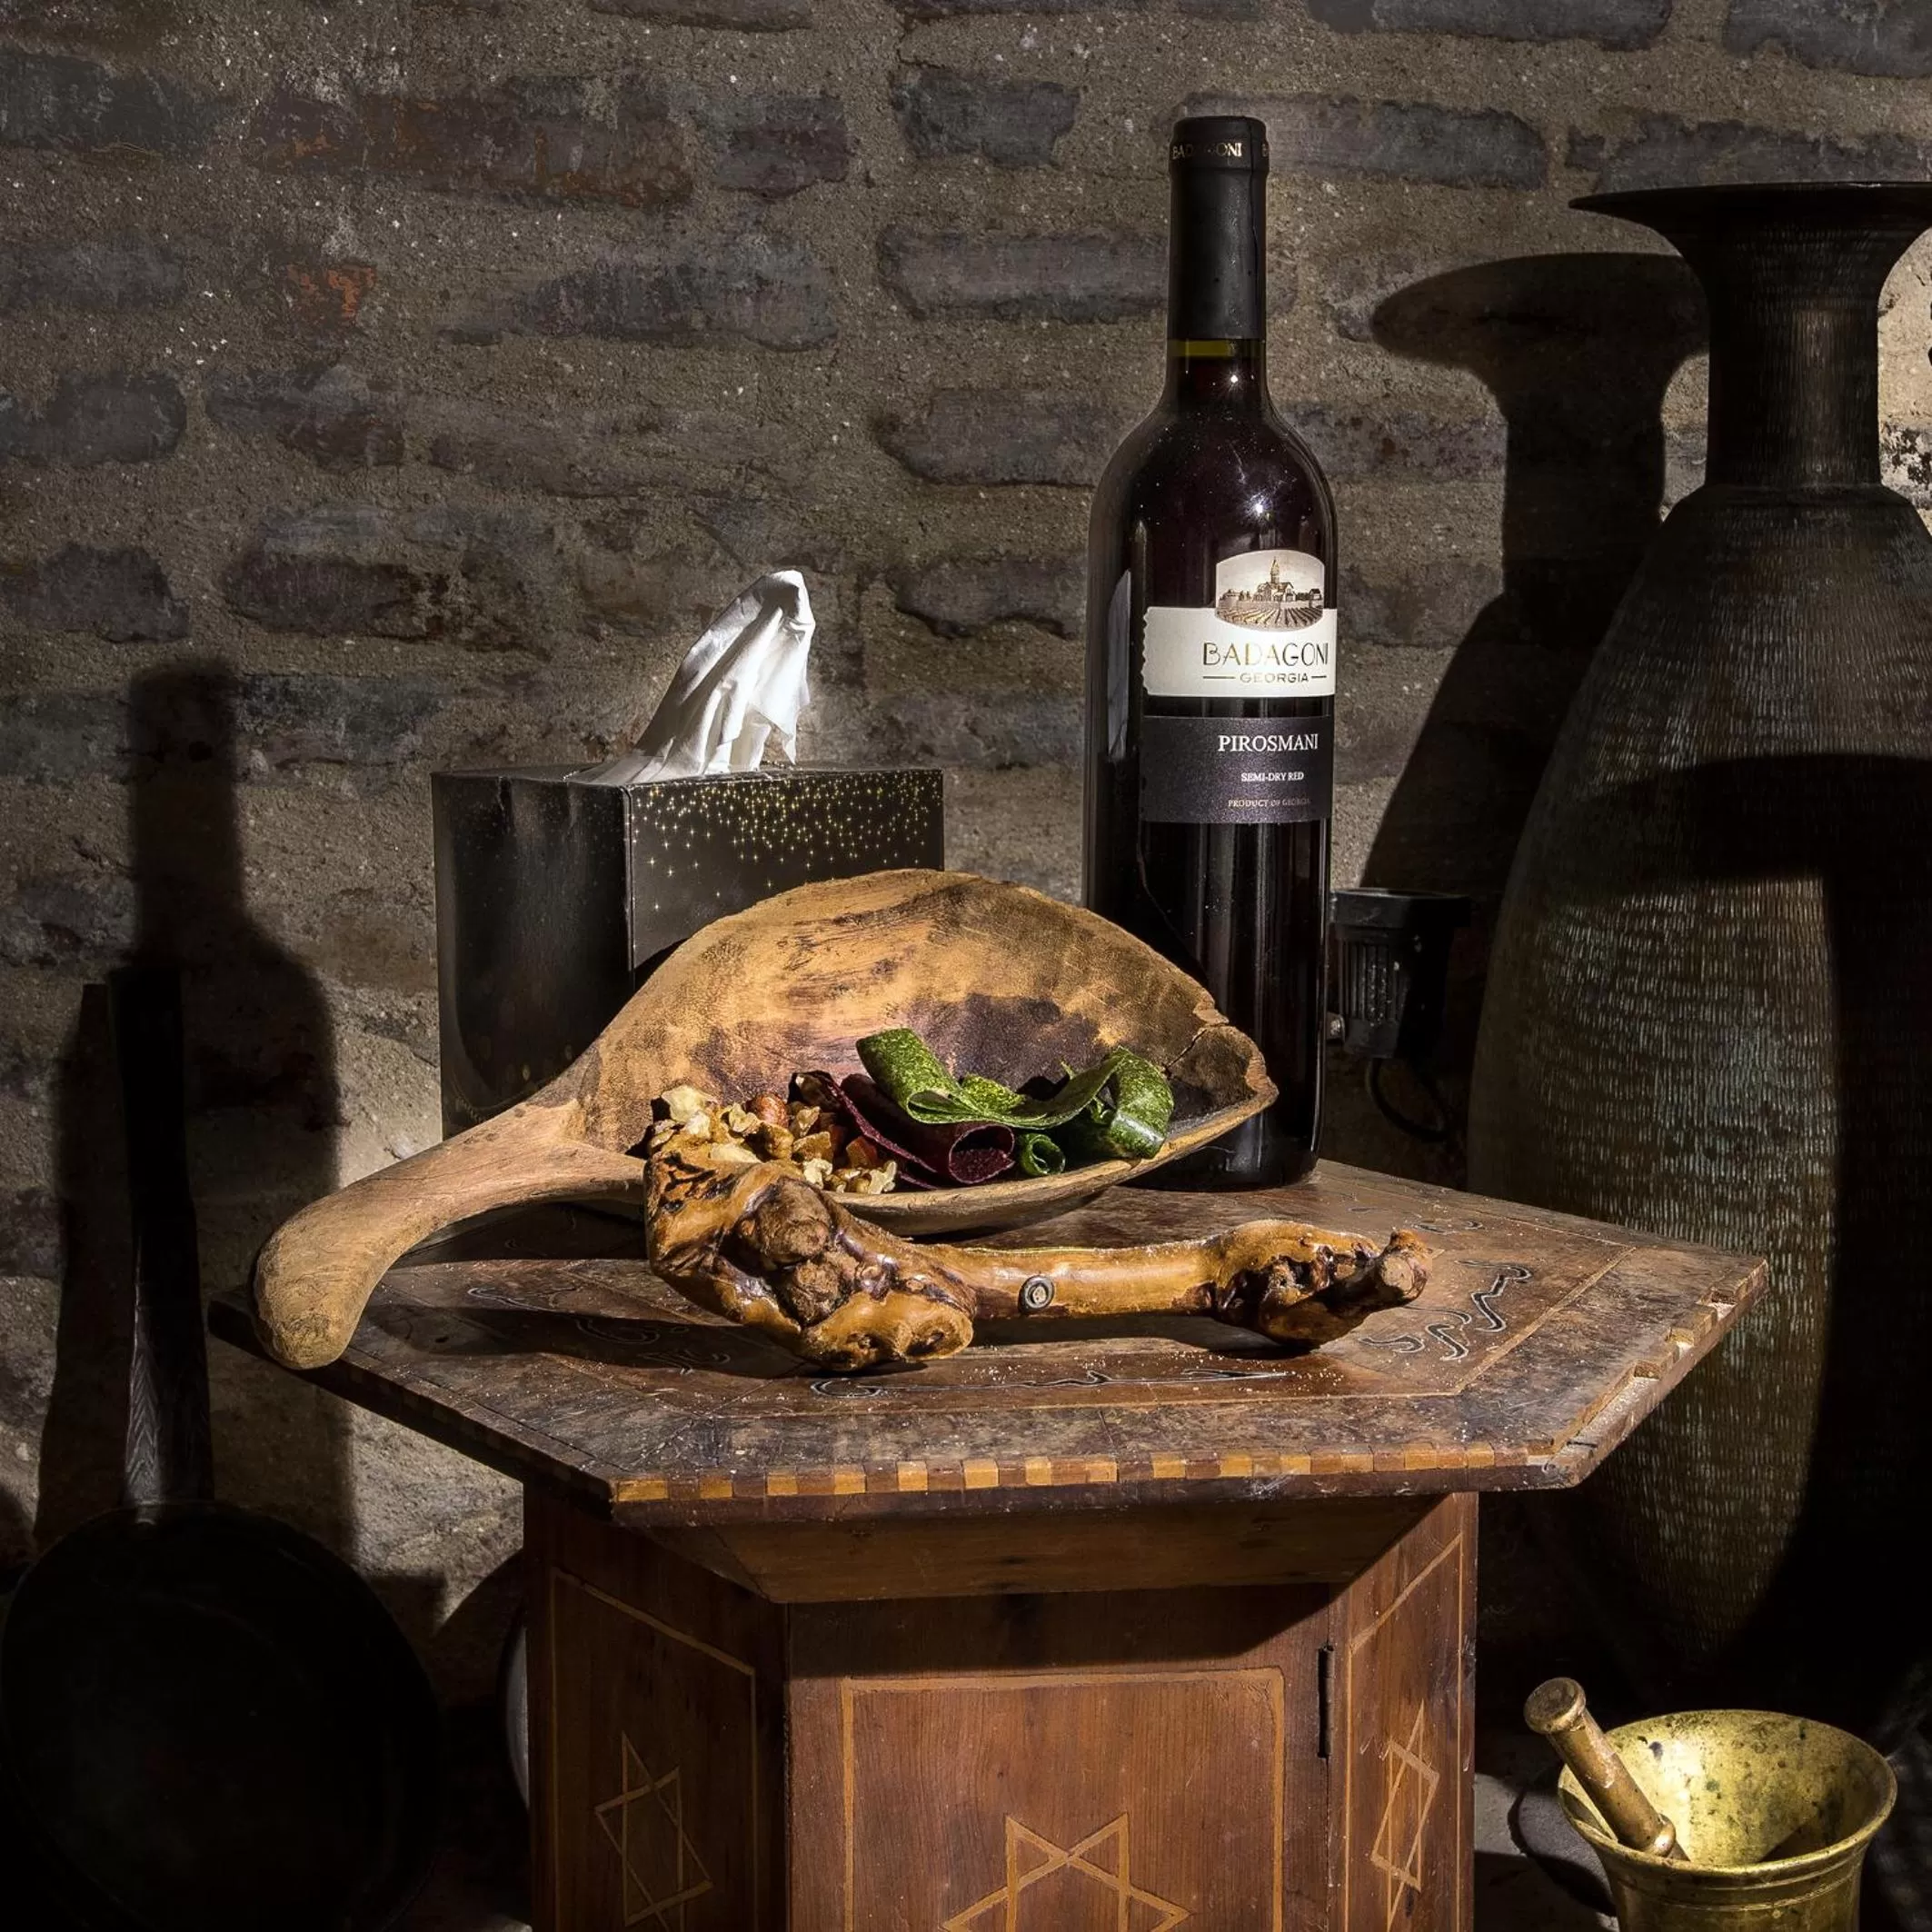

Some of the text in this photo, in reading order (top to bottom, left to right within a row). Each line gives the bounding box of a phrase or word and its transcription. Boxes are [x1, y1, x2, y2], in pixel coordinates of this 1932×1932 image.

[1172, 142, 1242, 160] BADONI
[1202, 642, 1329, 667] BADAGONI
[1240, 672, 1310, 684] GEORGIA
[1218, 733, 1319, 752] PIROSMANI
[1240, 771, 1305, 782] SEMI-DRY RED
[1228, 799, 1270, 807] PRODUCT
